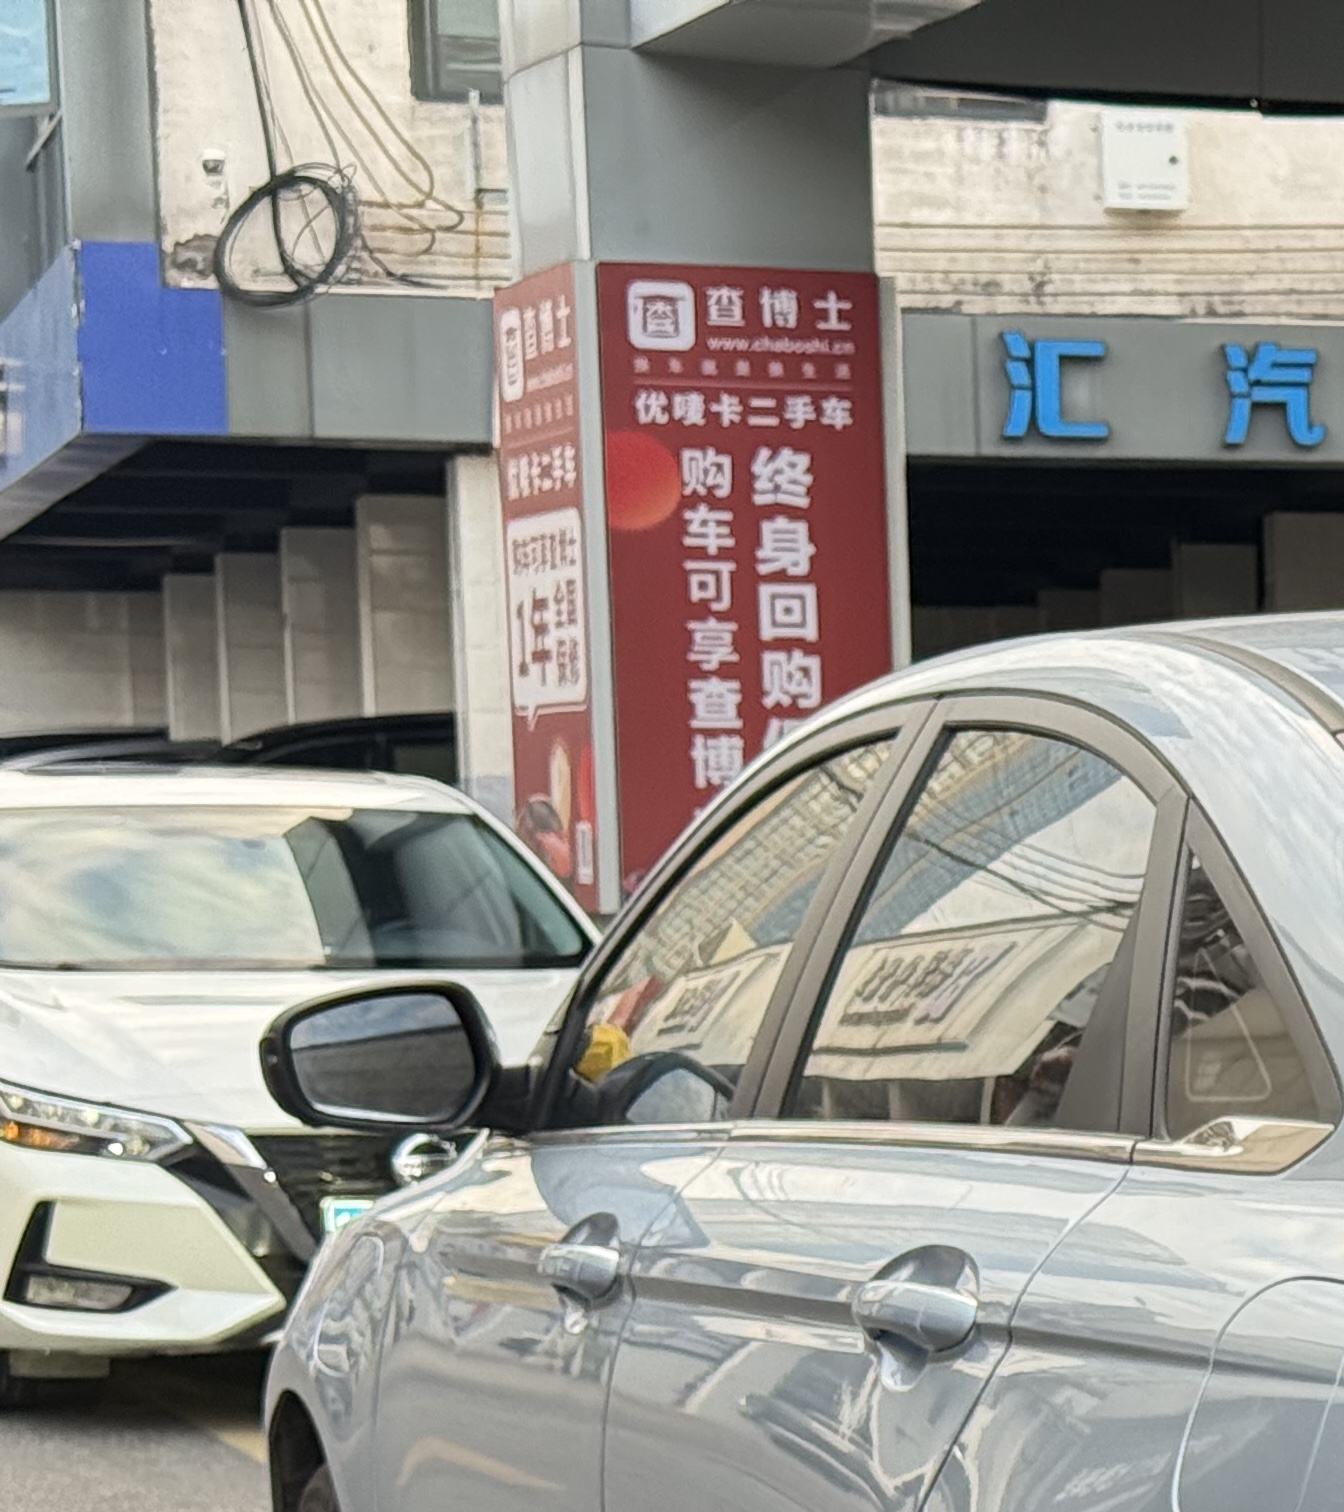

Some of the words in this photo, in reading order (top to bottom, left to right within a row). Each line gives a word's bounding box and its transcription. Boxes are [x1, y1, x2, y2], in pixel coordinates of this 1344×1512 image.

[704, 285, 853, 331] 查博士
[634, 389, 853, 430] 优唛卡二手车
[680, 446, 745, 817] 购车可享查博
